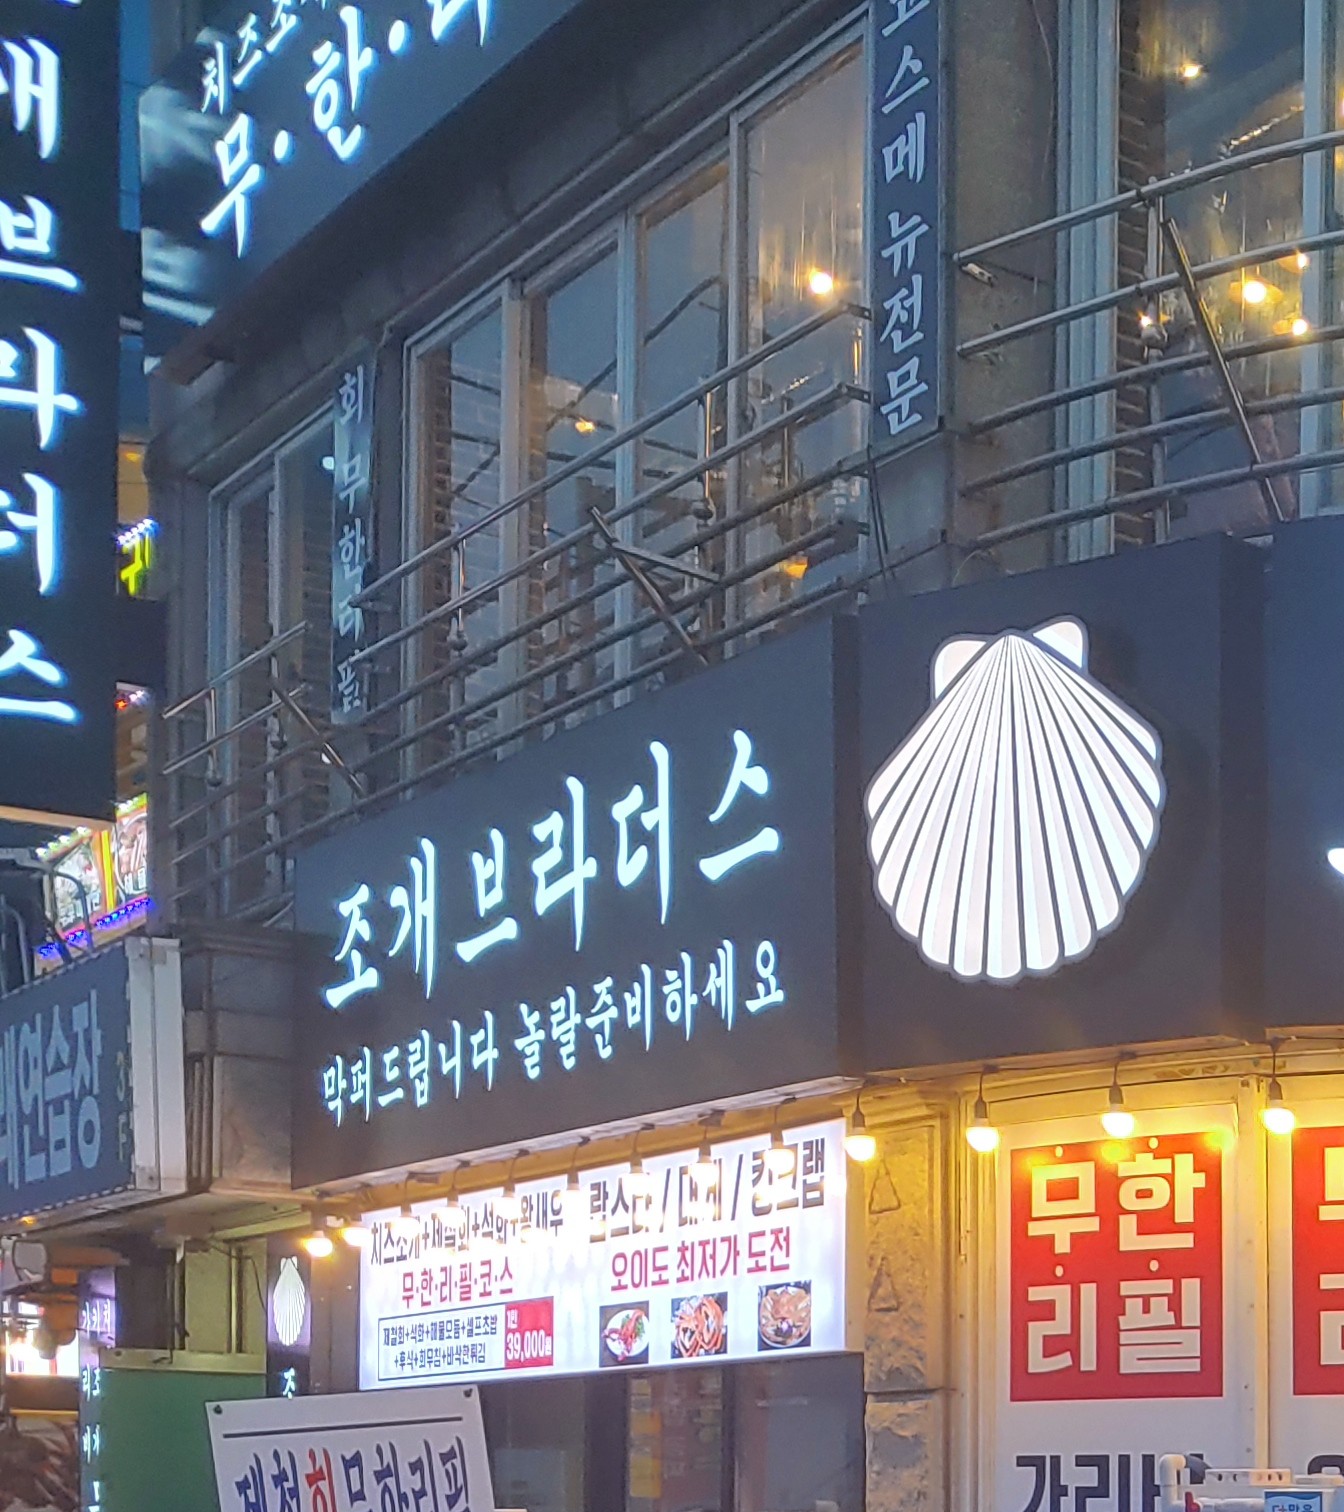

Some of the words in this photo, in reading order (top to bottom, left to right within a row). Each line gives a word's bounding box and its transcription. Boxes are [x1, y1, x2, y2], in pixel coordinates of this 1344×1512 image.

[324, 729, 783, 1010] 조개브라더스
[322, 1008, 500, 1129] 막퍼드립니다
[1027, 1152, 1206, 1254] 무한
[401, 1256, 514, 1309] 무·한·리·필·코·스
[610, 1244, 670, 1292] 오이도
[676, 1234, 740, 1284] 최저가
[747, 1226, 792, 1275] 도전
[506, 1328, 552, 1363] 39,000원
[1027, 1277, 1202, 1375] 리필
